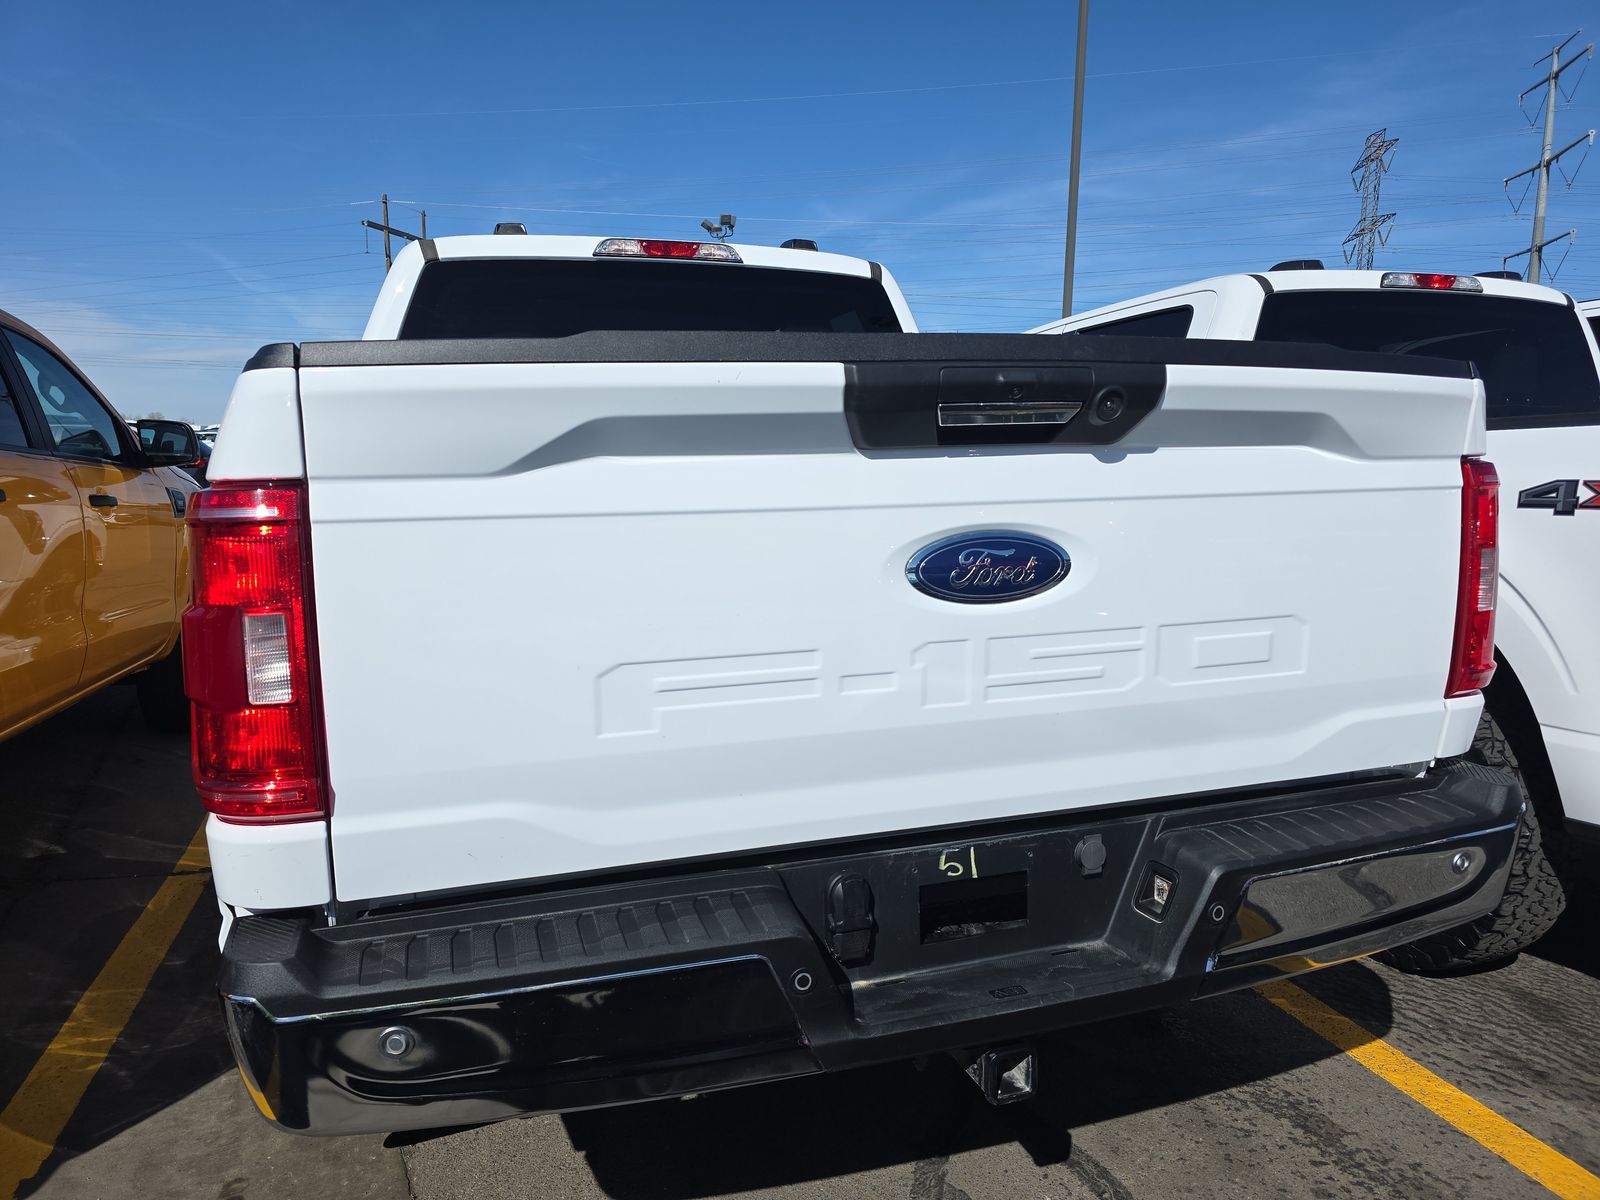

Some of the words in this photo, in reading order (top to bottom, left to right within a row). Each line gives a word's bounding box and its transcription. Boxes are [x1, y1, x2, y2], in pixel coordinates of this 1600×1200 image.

[950, 548, 1038, 589] Ford
[595, 614, 1308, 740] F-150
[939, 846, 978, 878] 51
